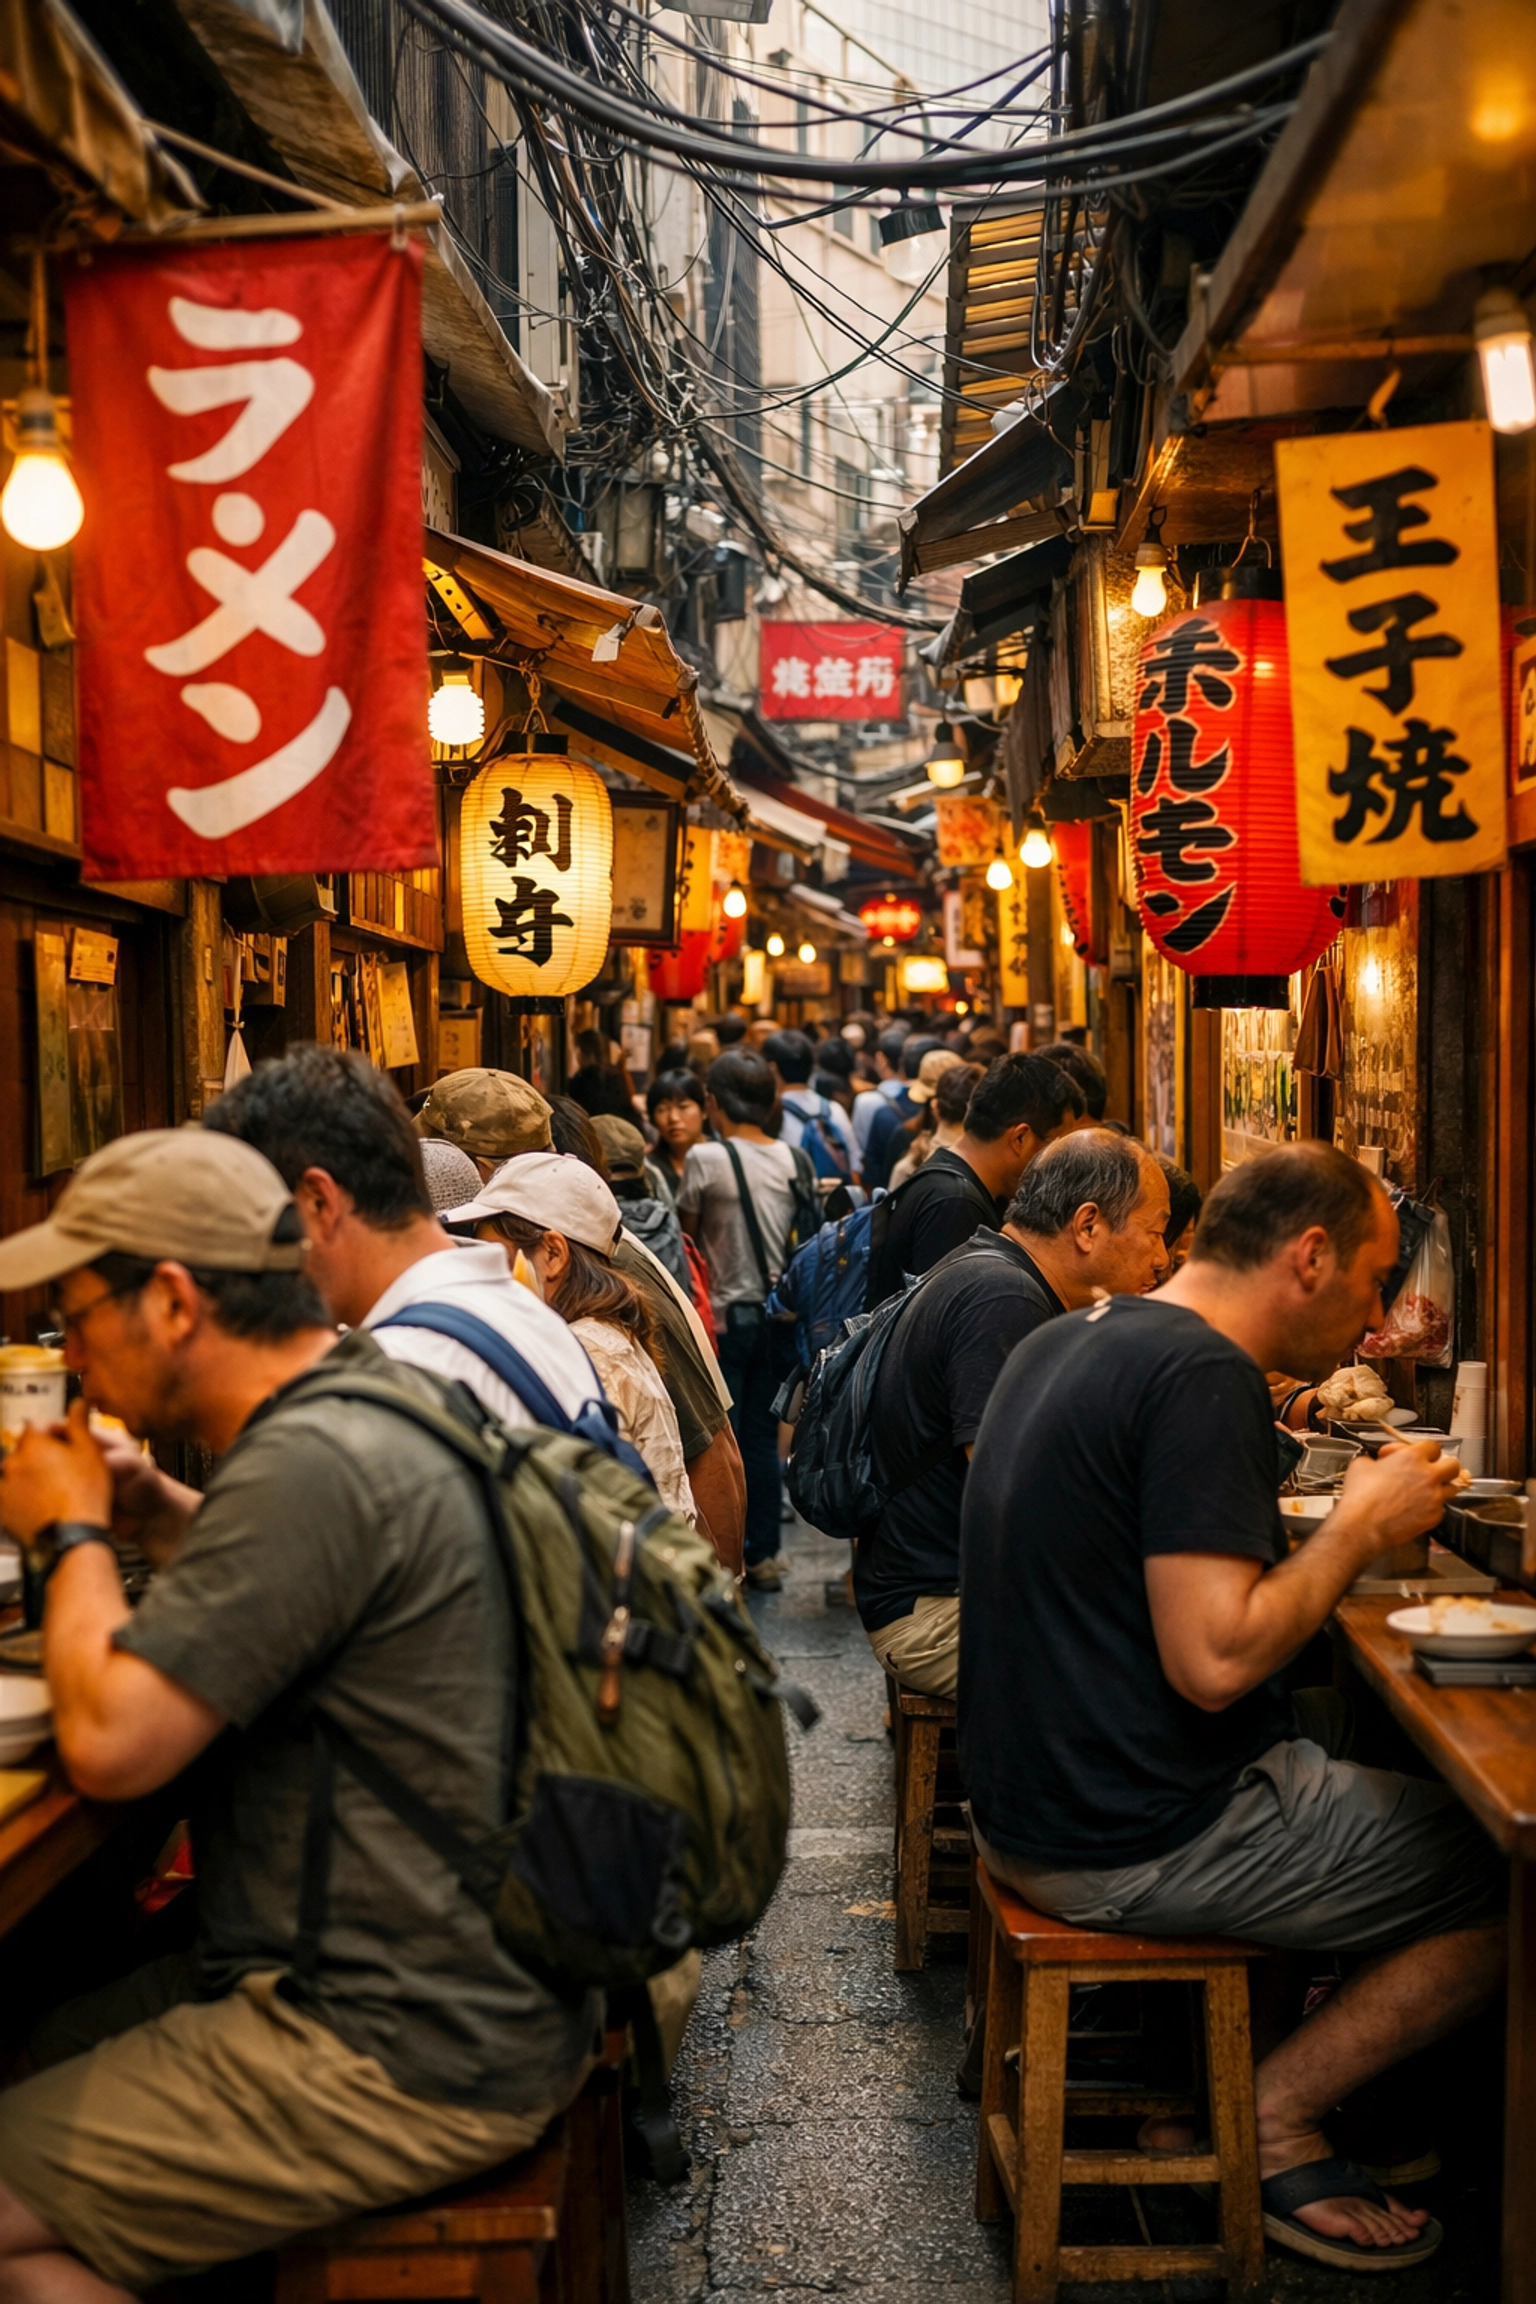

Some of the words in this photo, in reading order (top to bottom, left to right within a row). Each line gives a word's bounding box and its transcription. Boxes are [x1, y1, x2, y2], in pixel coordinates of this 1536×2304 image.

[1136, 617, 1242, 953] ホルモン
[1321, 467, 1479, 843] 王子焼
